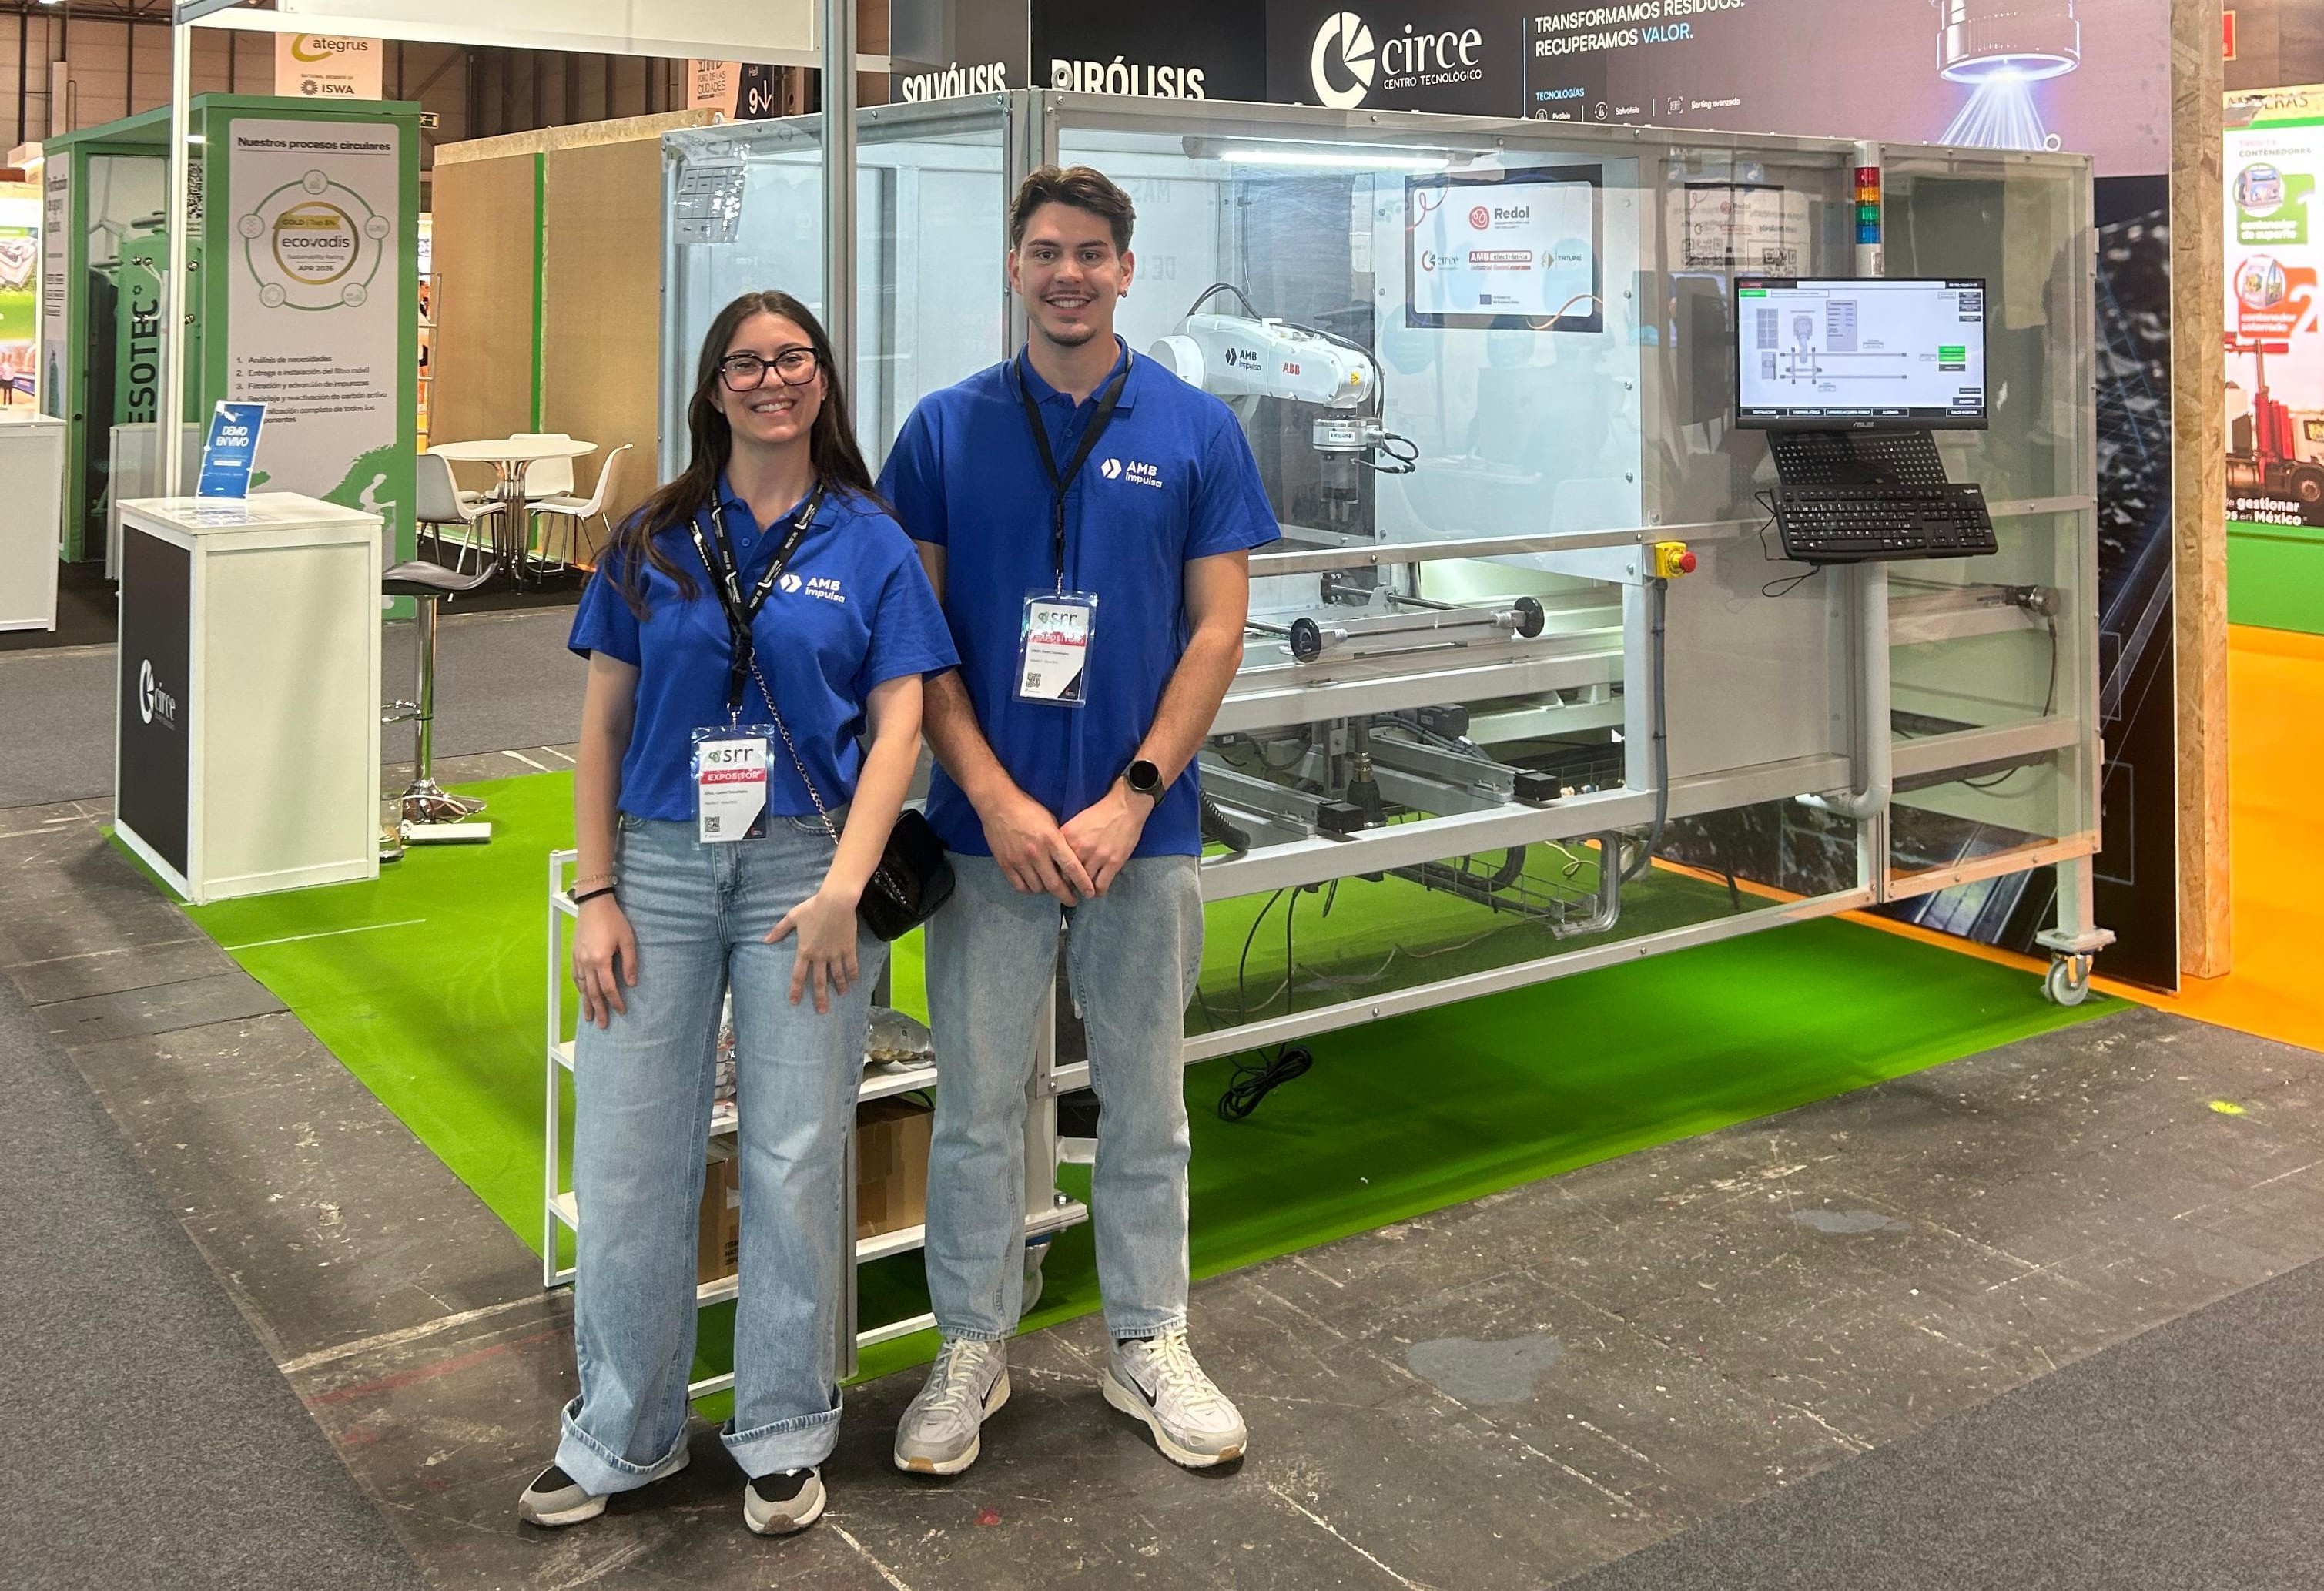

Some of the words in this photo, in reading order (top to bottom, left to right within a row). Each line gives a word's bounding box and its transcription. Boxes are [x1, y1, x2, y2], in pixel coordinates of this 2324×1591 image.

[1535, 2, 1660, 34] TRANSFORMAMOS
[313, 38, 369, 53] ategrus
[1535, 28, 1639, 58] RECUPERAMOS
[1641, 22, 1694, 44] VALOR.
[1381, 23, 1482, 75] circe
[902, 62, 1006, 103] SOLVÓLISIS
[1051, 55, 1206, 101] PIRÓLISIS
[1383, 77, 1418, 90] CENTRO
[1420, 69, 1482, 86] TECNOLÓGICO
[322, 84, 355, 95] ISWA
[1535, 87, 1586, 102] TECNOLOGÍAS
[748, 87, 758, 115] 9
[237, 136, 287, 149] Nuestros
[289, 139, 338, 150] procesos
[340, 141, 391, 151] circulares
[1494, 206, 1530, 220] Redol
[282, 235, 350, 248] ecovadis
[1239, 349, 1257, 361] AMB
[1283, 361, 1301, 376] ABB
[221, 426, 249, 437] DEMO
[1127, 461, 1158, 477] AMB
[1125, 471, 1164, 489] impulsa
[2236, 497, 2300, 513] gestionar
[806, 577, 841, 591] AMB
[723, 747, 754, 762] srr
